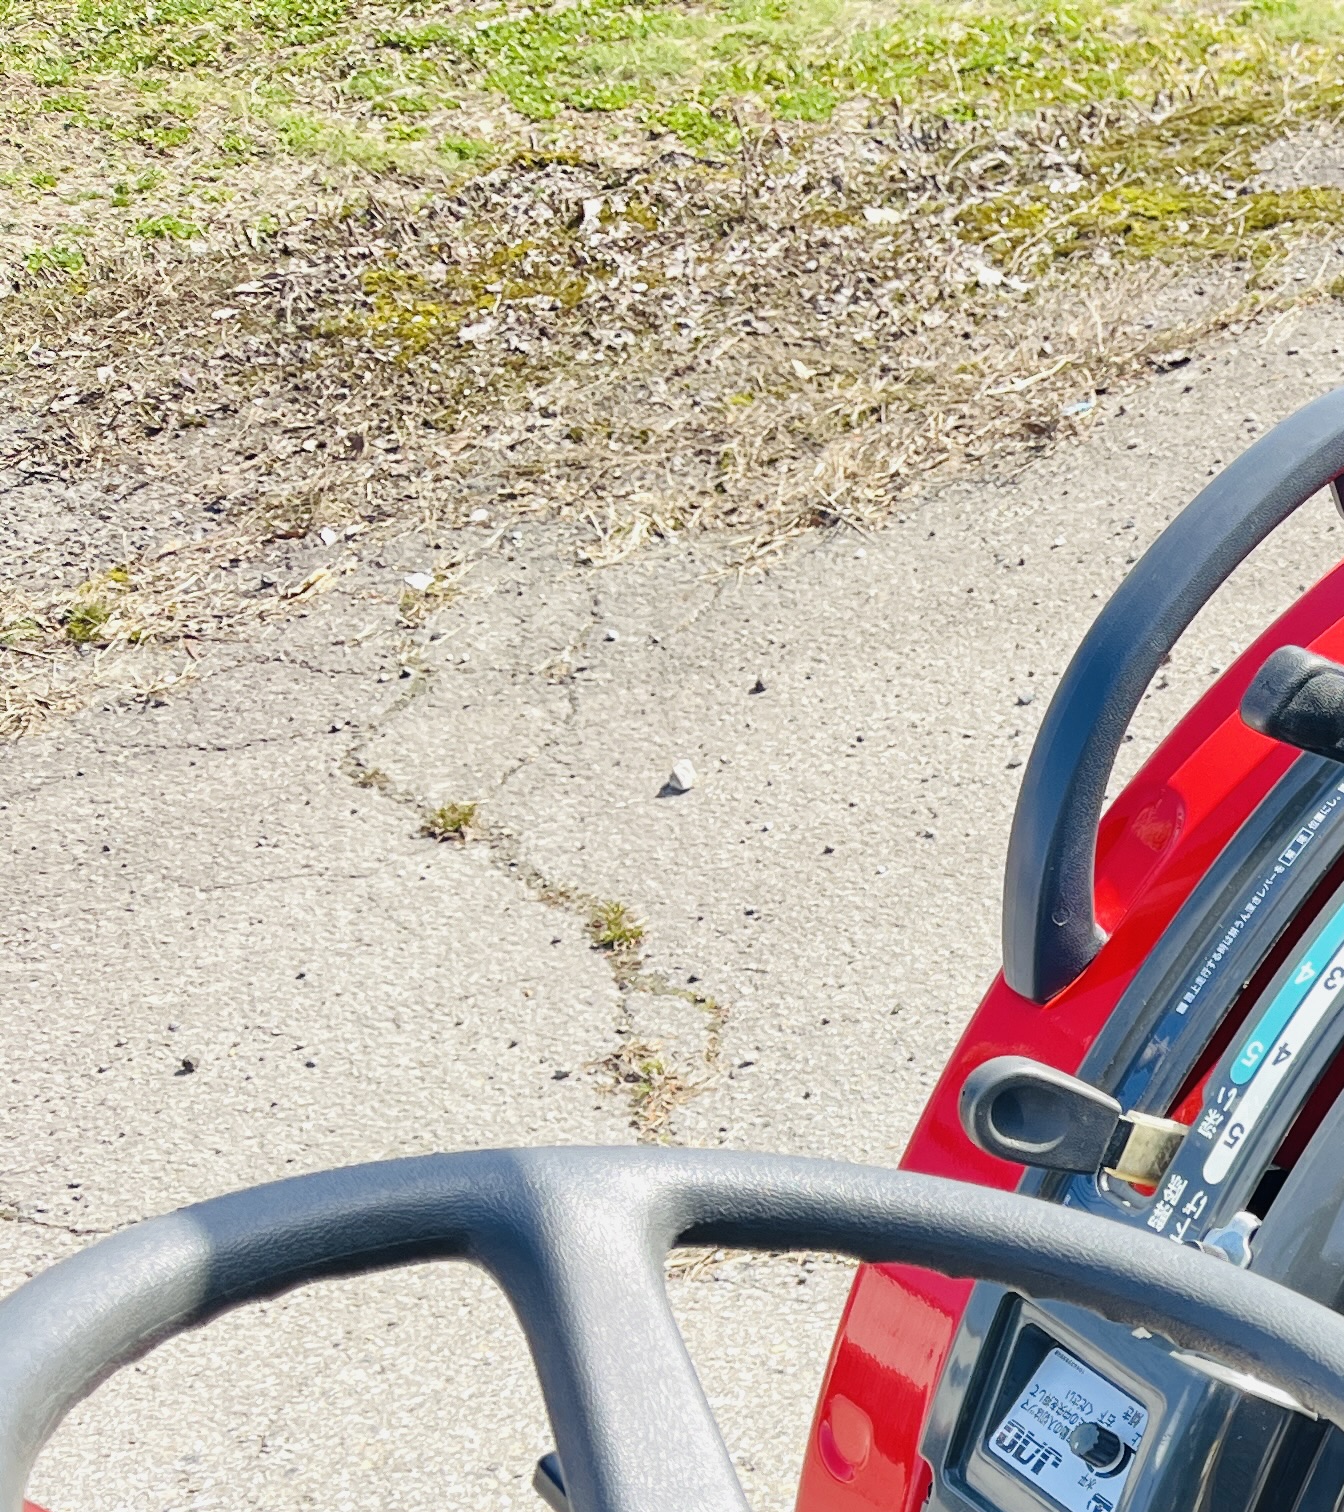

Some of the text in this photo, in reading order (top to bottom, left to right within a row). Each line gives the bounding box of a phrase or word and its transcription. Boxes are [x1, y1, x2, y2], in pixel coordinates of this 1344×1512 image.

[1292, 958, 1319, 988] 4
[1240, 1038, 1266, 1067] 5
[1270, 1040, 1295, 1069] 4
[1196, 1081, 1239, 1139] 深い
[1222, 1121, 1246, 1150] 5
[1145, 1172, 1189, 1233] 解除
[1166, 1186, 1210, 1243] 下げ
[1077, 1471, 1096, 1490] 水平
